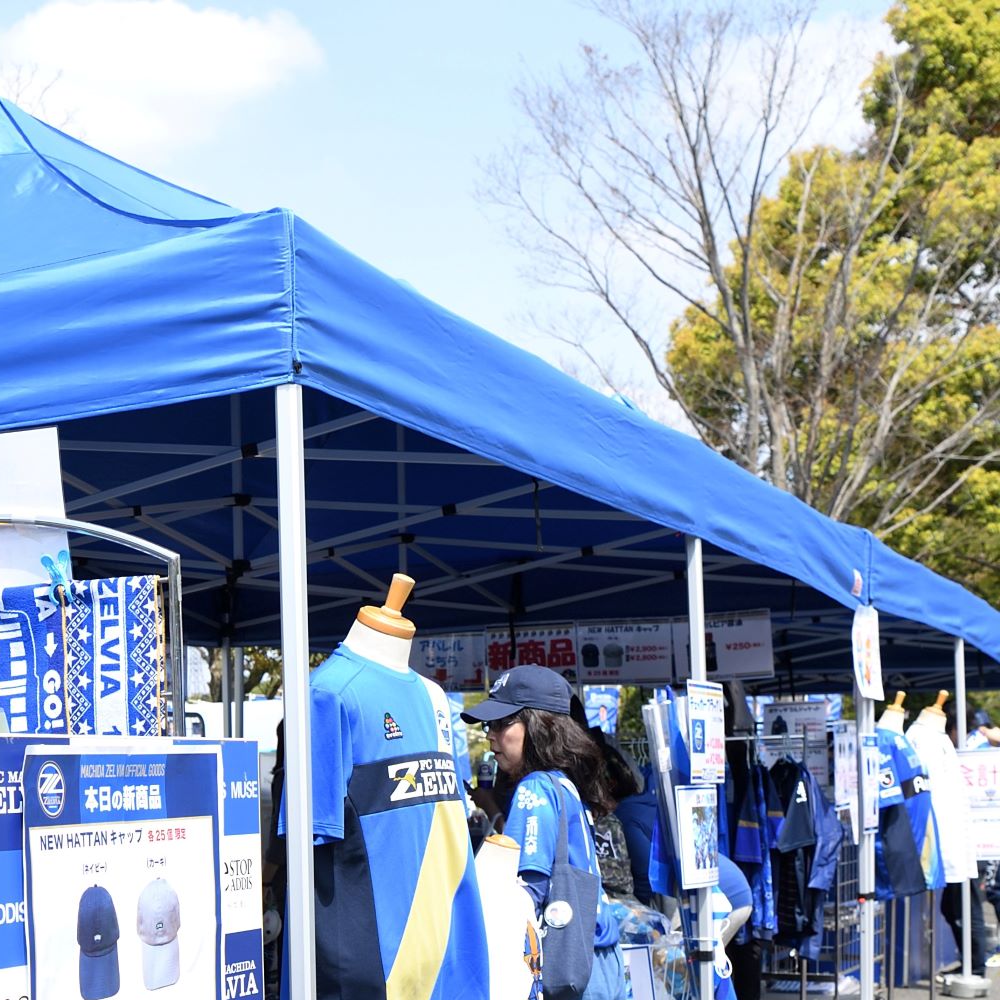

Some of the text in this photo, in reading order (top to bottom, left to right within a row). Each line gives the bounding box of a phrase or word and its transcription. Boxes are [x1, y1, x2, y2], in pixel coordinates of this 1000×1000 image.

[98, 578, 122, 698] ZELVIA
[43, 668, 65, 730] GO!
[80, 763, 105, 779] MACHIDA
[147, 763, 166, 777] GOODS
[419, 760, 433, 770] FC
[84, 784, 162, 813] 本日の新商品
[231, 778, 259, 800] MUSE
[39, 835, 64, 851] NEW
[66, 830, 108, 849] HATTAN
[110, 828, 143, 846] キャップ
[230, 858, 253, 879] STOP
[230, 876, 253, 892] ADDIS
